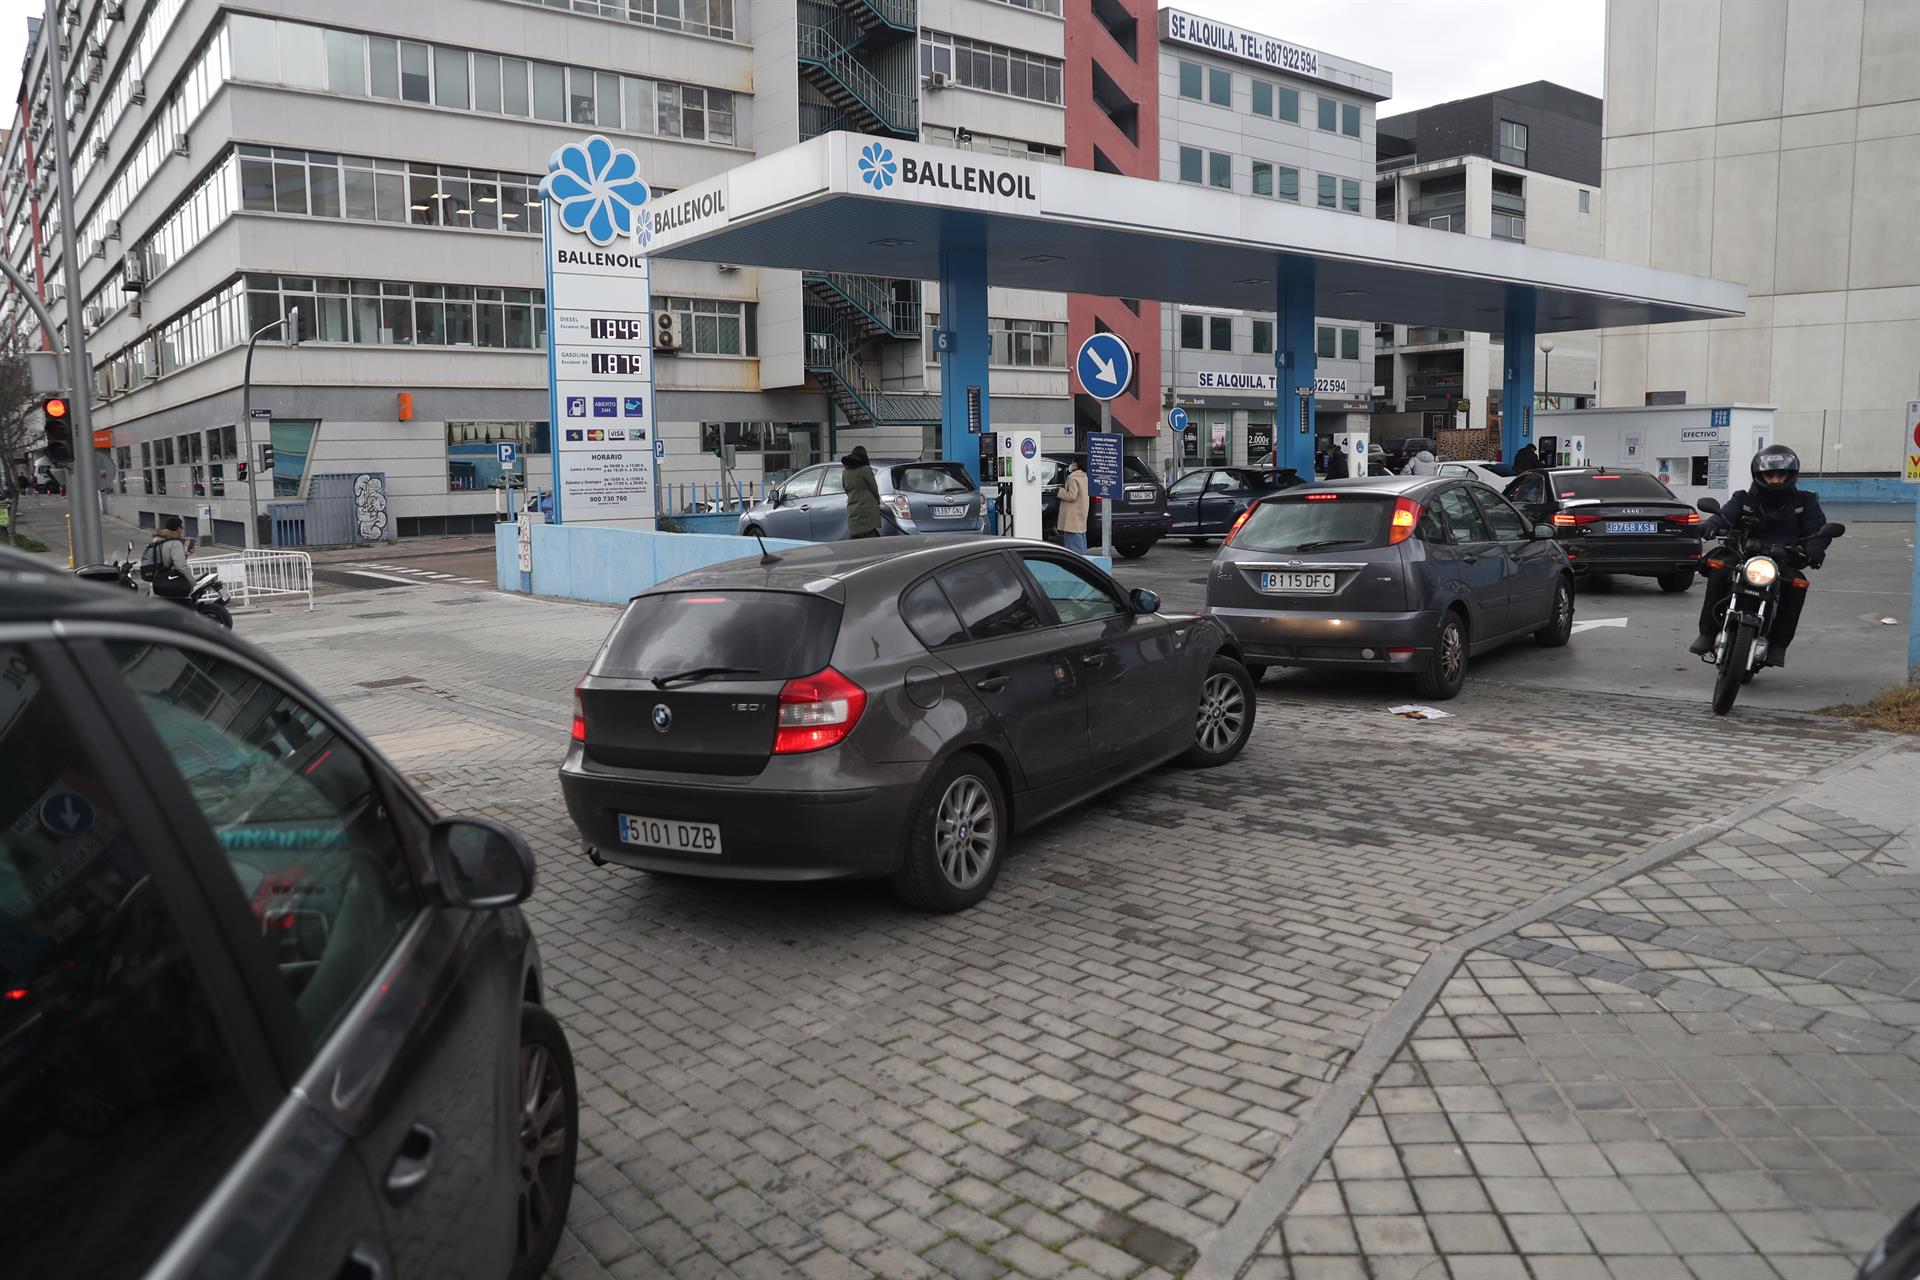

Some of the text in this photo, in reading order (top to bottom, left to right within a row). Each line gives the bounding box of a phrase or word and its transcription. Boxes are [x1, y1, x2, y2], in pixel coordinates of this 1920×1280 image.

[1172, 14, 1186, 38] SE
[1189, 19, 1238, 53] ALQUILA.
[1240, 33, 1262, 59] TEL:
[903, 158, 1036, 200] BALLENOIL
[654, 189, 726, 235] BALLENOIL
[558, 250, 642, 268] BALLENOIL
[596, 320, 640, 340] 1.849
[939, 333, 948, 348] 6
[598, 354, 642, 374] 1.879
[1279, 352, 1285, 366] 4
[1508, 368, 1512, 379] 2
[1200, 373, 1346, 392] SE ALQUILA. T 922594
[1006, 437, 1011, 448] 6
[1249, 436, 1269, 444] 2.000€
[1342, 438, 1348, 446] 4
[501, 446, 512, 460] P
[1910, 456, 1920, 467] V
[1612, 522, 1636, 532] 9768
[1639, 522, 1655, 531] KS
[1269, 572, 1331, 588] 8115 DFC
[629, 822, 716, 849] 5101 DZB
